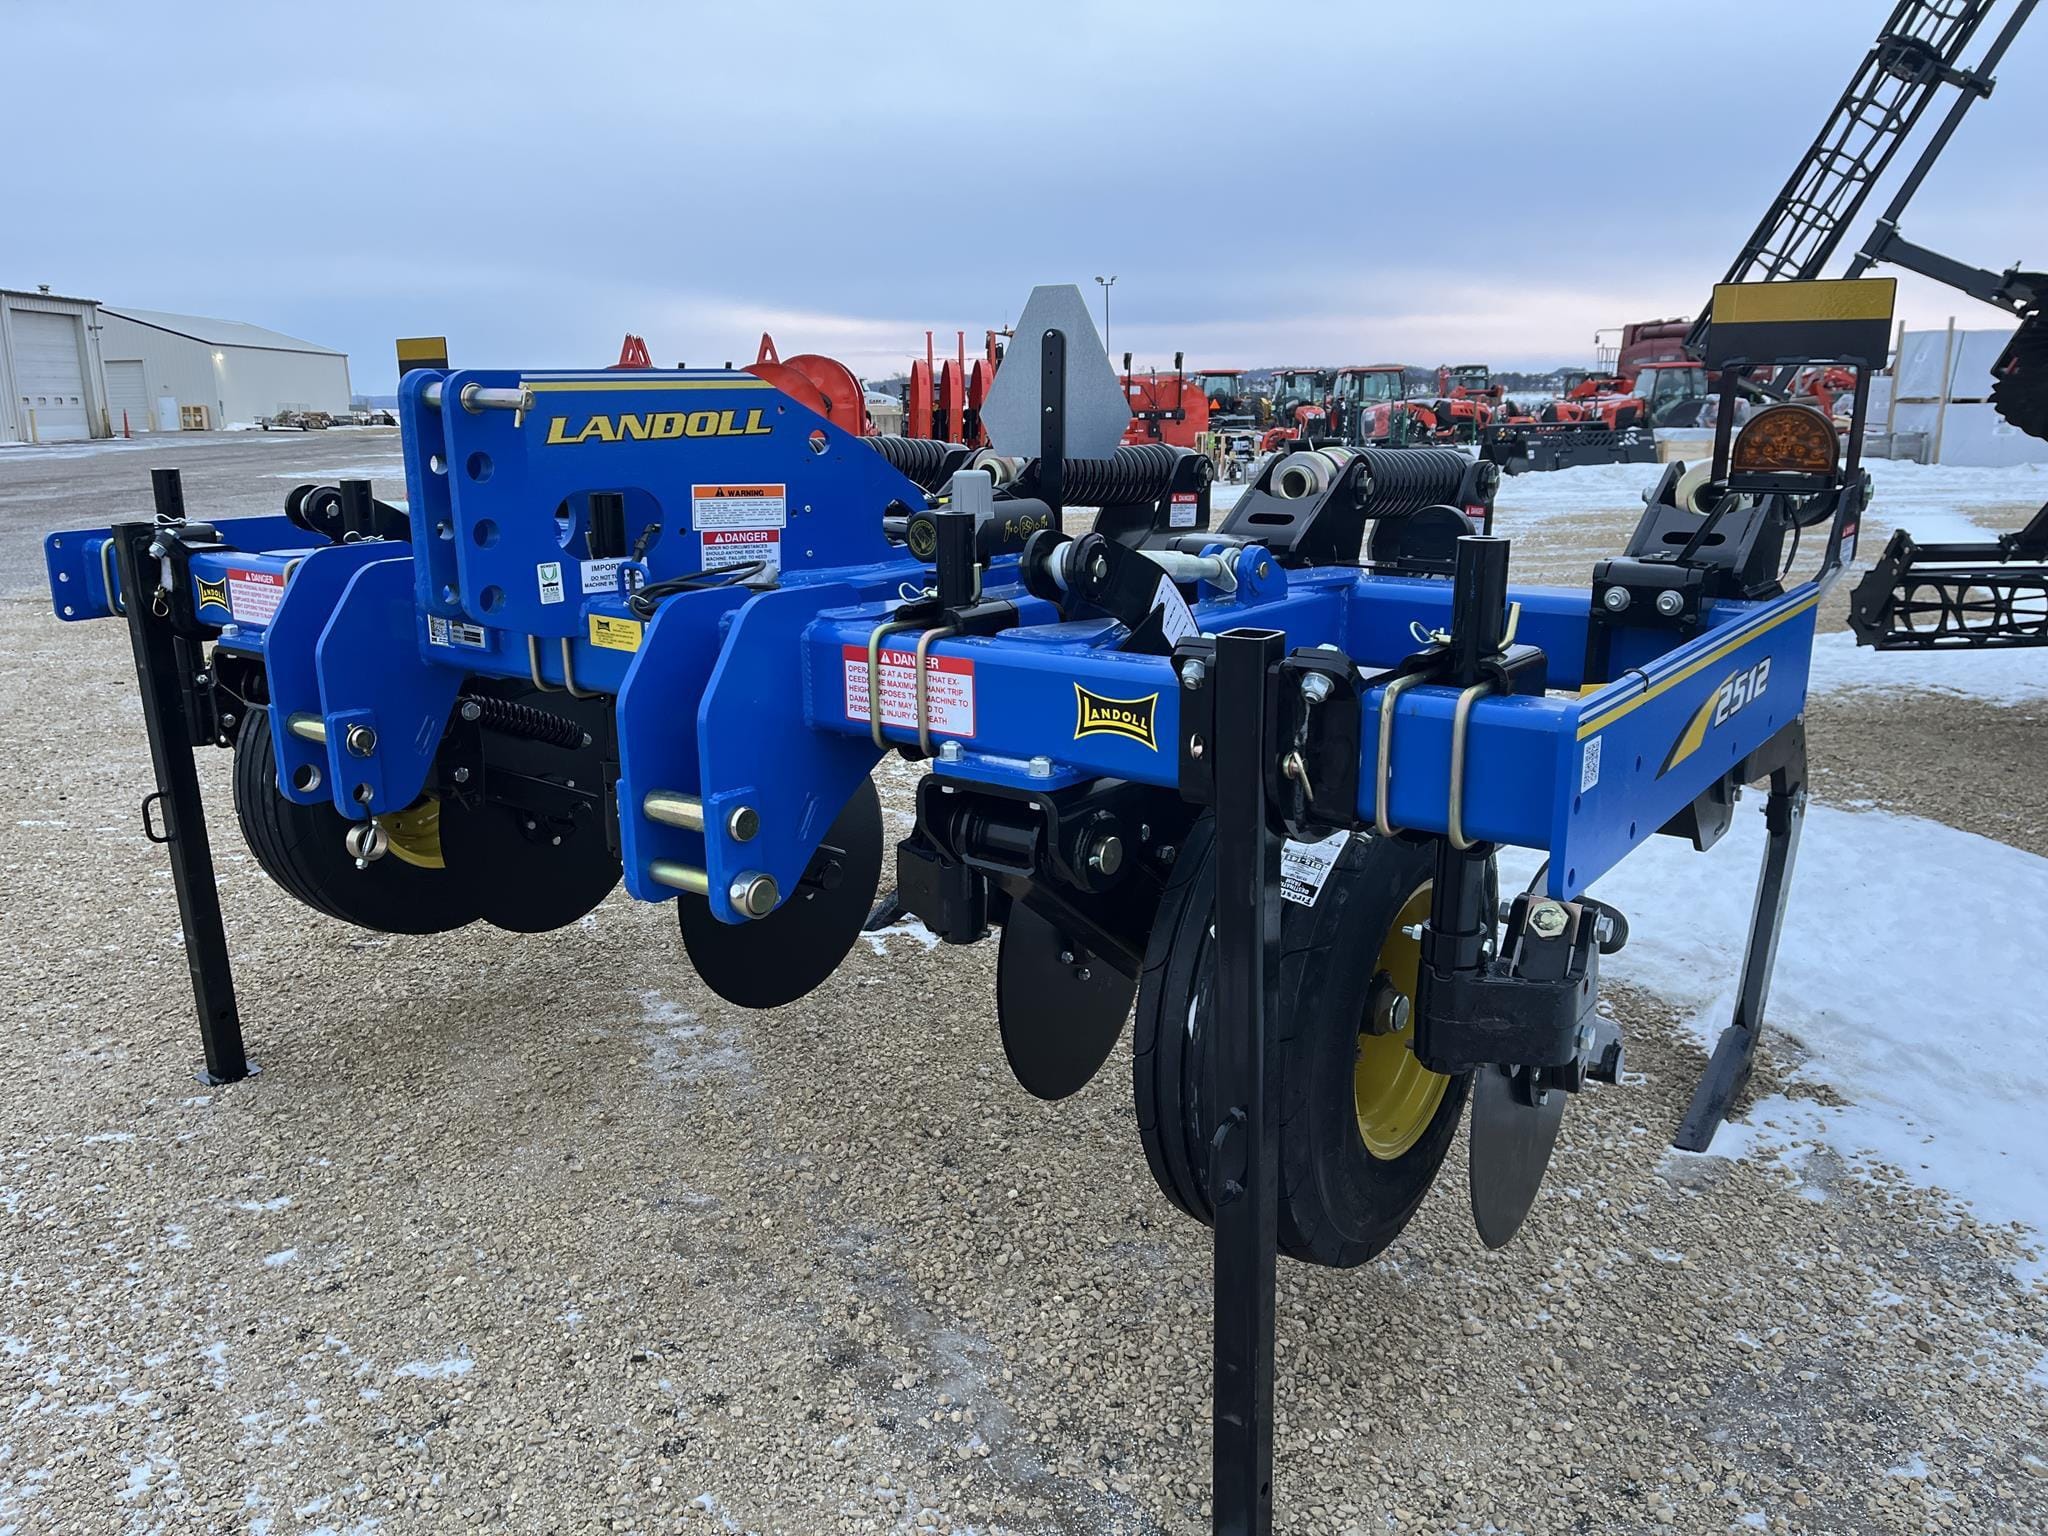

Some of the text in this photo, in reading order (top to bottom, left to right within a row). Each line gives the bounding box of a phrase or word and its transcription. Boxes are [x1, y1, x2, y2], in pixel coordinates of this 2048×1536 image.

[545, 408, 773, 445] LANDOLL
[727, 489, 765, 497] WARNING
[724, 532, 768, 543] DANGER
[250, 572, 275, 585] DANGER
[584, 580, 608, 589] MACHINE
[199, 580, 226, 605] LANDOLL
[893, 652, 939, 670] DANER
[887, 670, 896, 678] AT
[928, 674, 946, 684] THAT
[947, 677, 960, 685] EX-
[848, 684, 870, 694] HEIGH
[879, 689, 907, 700] XPOSES
[958, 699, 969, 708] TO
[926, 685, 945, 695] HANK
[947, 688, 963, 696] TRIP
[1712, 655, 1772, 729] 2512
[849, 694, 870, 704] DAMA
[880, 698, 896, 708] THAT
[897, 701, 913, 710] MAY
[934, 706, 944, 714] TO
[886, 709, 911, 720] INJURY
[927, 716, 948, 726] EATH
[1083, 696, 1148, 737] LANDOLL
